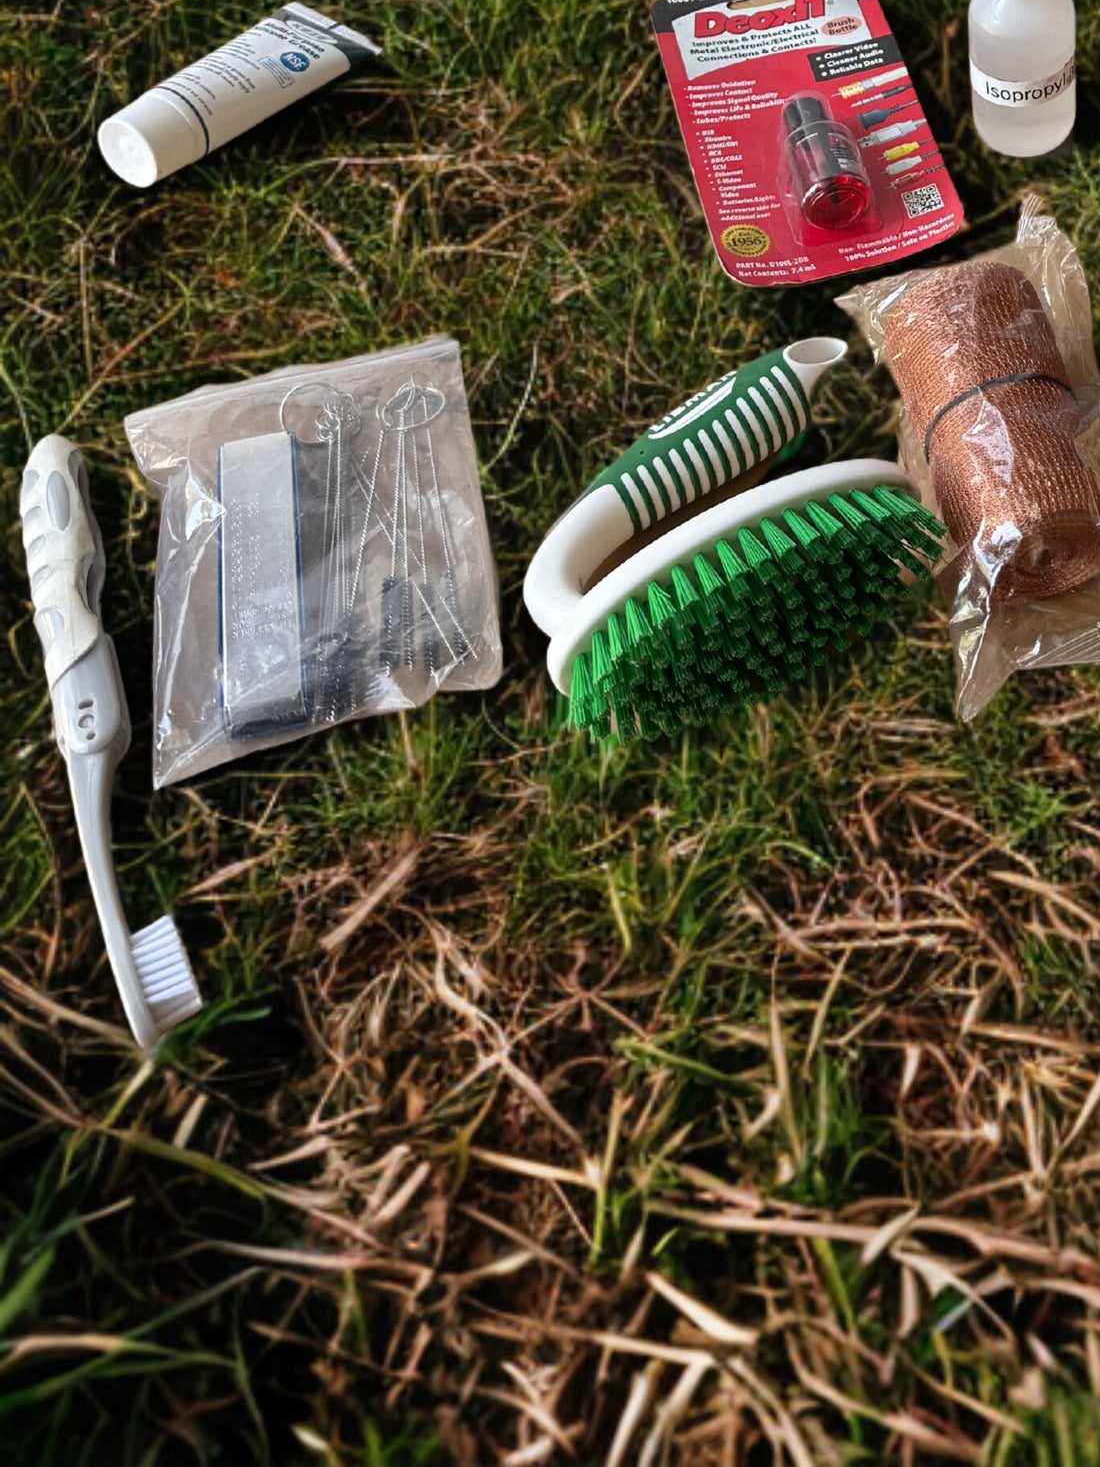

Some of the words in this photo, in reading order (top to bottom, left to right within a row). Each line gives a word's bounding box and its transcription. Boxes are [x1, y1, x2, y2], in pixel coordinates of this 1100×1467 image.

[826, 17, 855, 29] Brush
[827, 23, 858, 36] Bottle
[689, 47, 720, 56] Metal
[721, 29, 819, 53] Electronic/Electrical
[692, 36, 740, 49] Improves
[740, 35, 750, 43] &
[751, 28, 792, 41] Protects
[793, 23, 813, 34] ALL
[697, 50, 760, 63] Connections
[761, 47, 770, 55] &
[771, 38, 817, 53] Contacts!
[854, 42, 879, 53] Video
[282, 52, 308, 71] NSF
[827, 55, 859, 68] Cleaner
[859, 48, 884, 60] Audio
[829, 62, 863, 75] Reliable
[863, 58, 884, 68] Data
[687, 83, 720, 92] Removes
[720, 79, 757, 89] Oxidation
[985, 72, 1067, 104] Isopropyl
[689, 91, 724, 101] Improves
[725, 87, 753, 96] Contact
[691, 98, 726, 109] Improves
[727, 96, 751, 106] Signal
[751, 91, 779, 101] Quality
[694, 108, 729, 117] Improves
[729, 104, 744, 113] Life
[696, 112, 751, 125] Lubes/Protects
[704, 135, 732, 143] Firewire
[708, 149, 722, 157] RCA
[710, 154, 743, 164] BNC/COAX
[714, 169, 744, 178] Ethernet
[716, 177, 742, 185] S-Video
[718, 182, 757, 192] Component
[722, 194, 776, 206] Batteries/Lights
[731, 206, 756, 214] reverse
[720, 213, 756, 222] additional
[731, 236, 762, 247] 1956
[844, 252, 866, 262] 100%
[865, 244, 898, 258] Solution
[901, 238, 919, 248] Safe
[918, 234, 929, 242] on
[928, 221, 956, 238] Plastics
[856, 234, 898, 250] Flammable
[738, 270, 753, 278] Net
[753, 269, 789, 278] Contents:
[791, 266, 804, 275] 7.4
